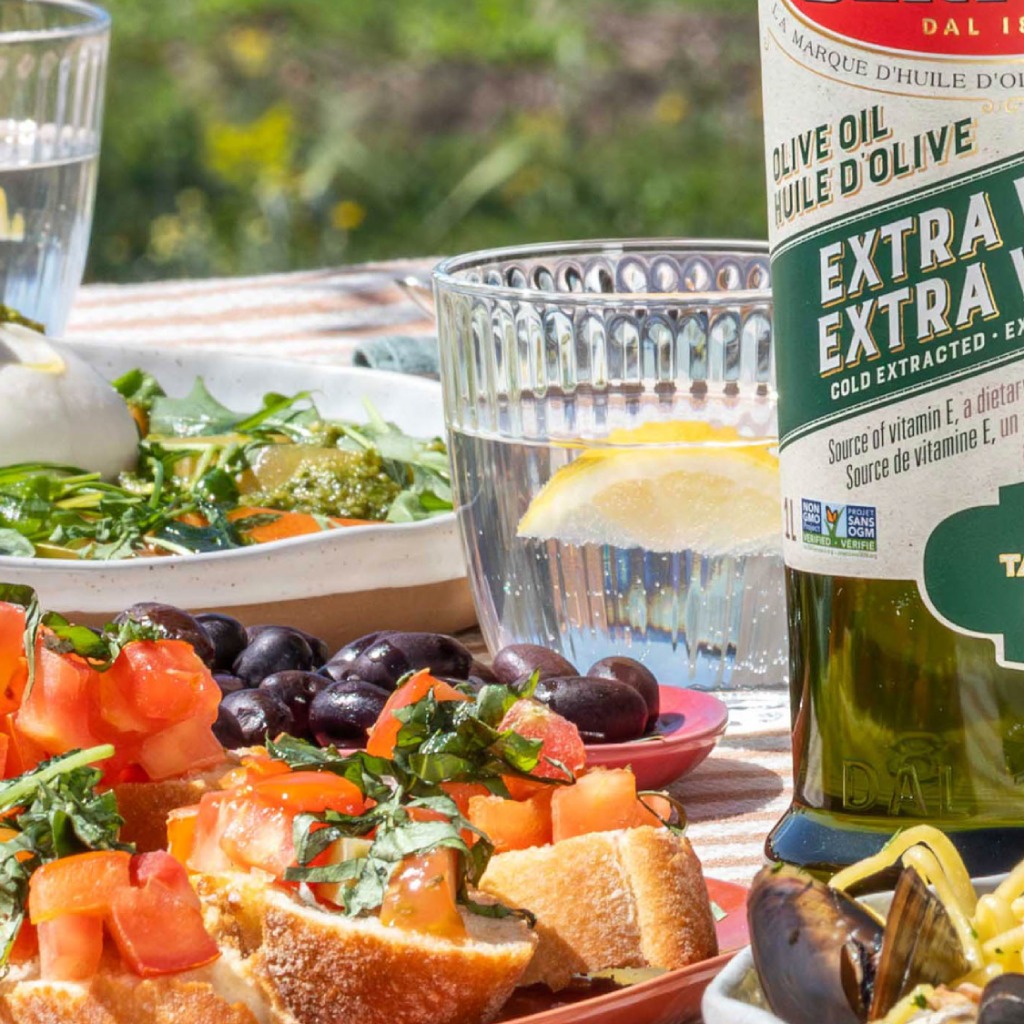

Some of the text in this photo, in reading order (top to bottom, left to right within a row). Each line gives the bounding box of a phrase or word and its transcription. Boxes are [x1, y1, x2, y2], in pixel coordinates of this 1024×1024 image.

[771, 3, 786, 34] LA
[791, 30, 868, 77] MARQUE
[876, 64, 966, 88] D'HUILE
[922, 17, 980, 36] DAL
[773, 105, 892, 183] OLIVE OIL
[775, 117, 976, 227] HUILE D'OLIVE
[819, 192, 1003, 309] EXTRA
[817, 262, 1000, 378] EXTRA
[830, 371, 871, 400] COLD
[876, 332, 986, 384] EXTRACTED
[828, 432, 869, 465] Source
[872, 425, 886, 447] of
[889, 406, 941, 444] vitamin
[946, 398, 960, 426] E,
[963, 399, 972, 419] a
[846, 458, 890, 490] Source
[893, 448, 910, 475] de
[914, 427, 978, 469] vitamine
[982, 418, 996, 446] E,
[999, 413, 1019, 439] un
[784, 497, 797, 542] 1L
[803, 502, 820, 514] NON
[803, 512, 821, 523] GMO
[848, 508, 875, 516] PROJET
[848, 516, 875, 527] SANS
[848, 526, 875, 538] OGM
[802, 532, 832, 546] VERIFIED
[842, 760, 958, 816] DAL
